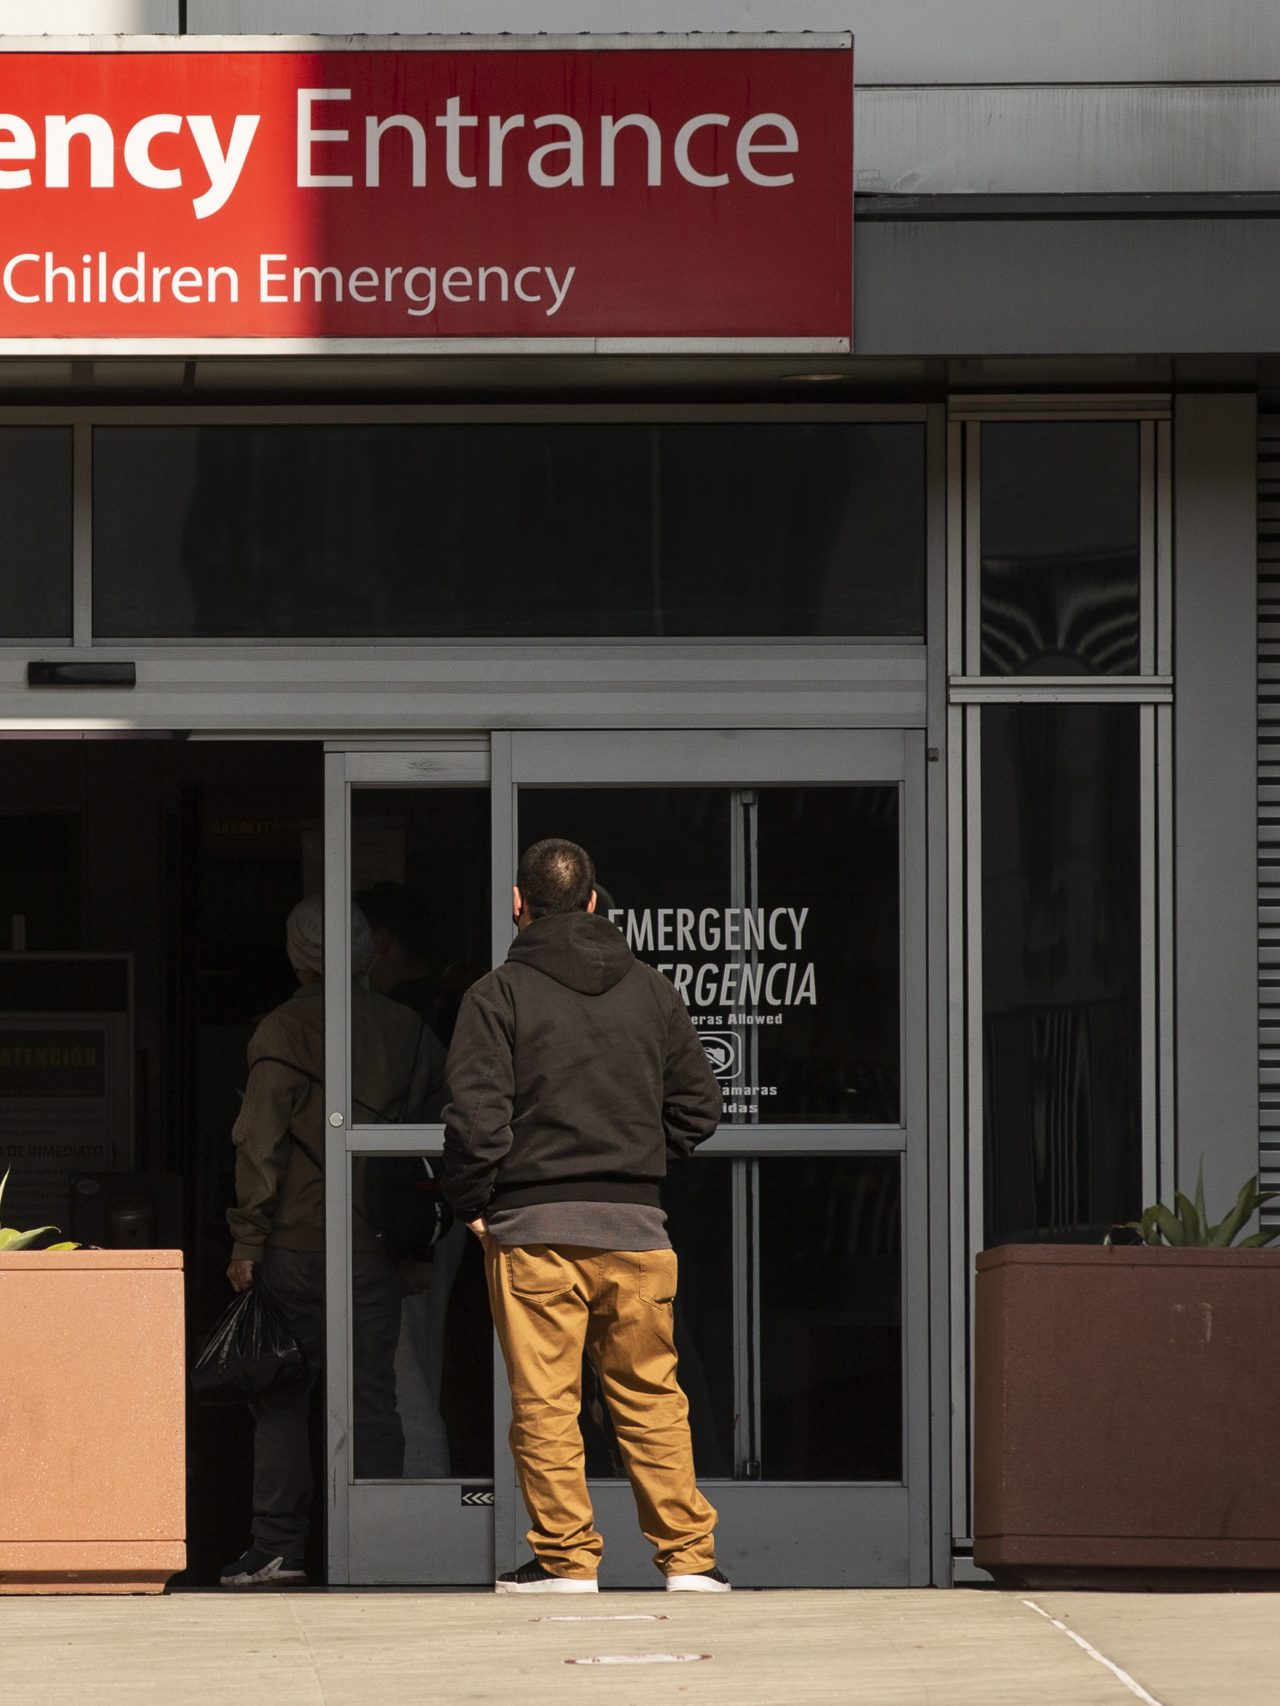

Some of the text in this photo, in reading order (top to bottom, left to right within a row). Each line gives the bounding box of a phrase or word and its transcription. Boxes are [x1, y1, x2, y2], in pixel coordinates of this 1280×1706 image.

[296, 87, 801, 189] Entrance
[2, 251, 238, 304] Children
[259, 253, 576, 316] Emergency
[691, 1013, 783, 1025] eras Allowed
